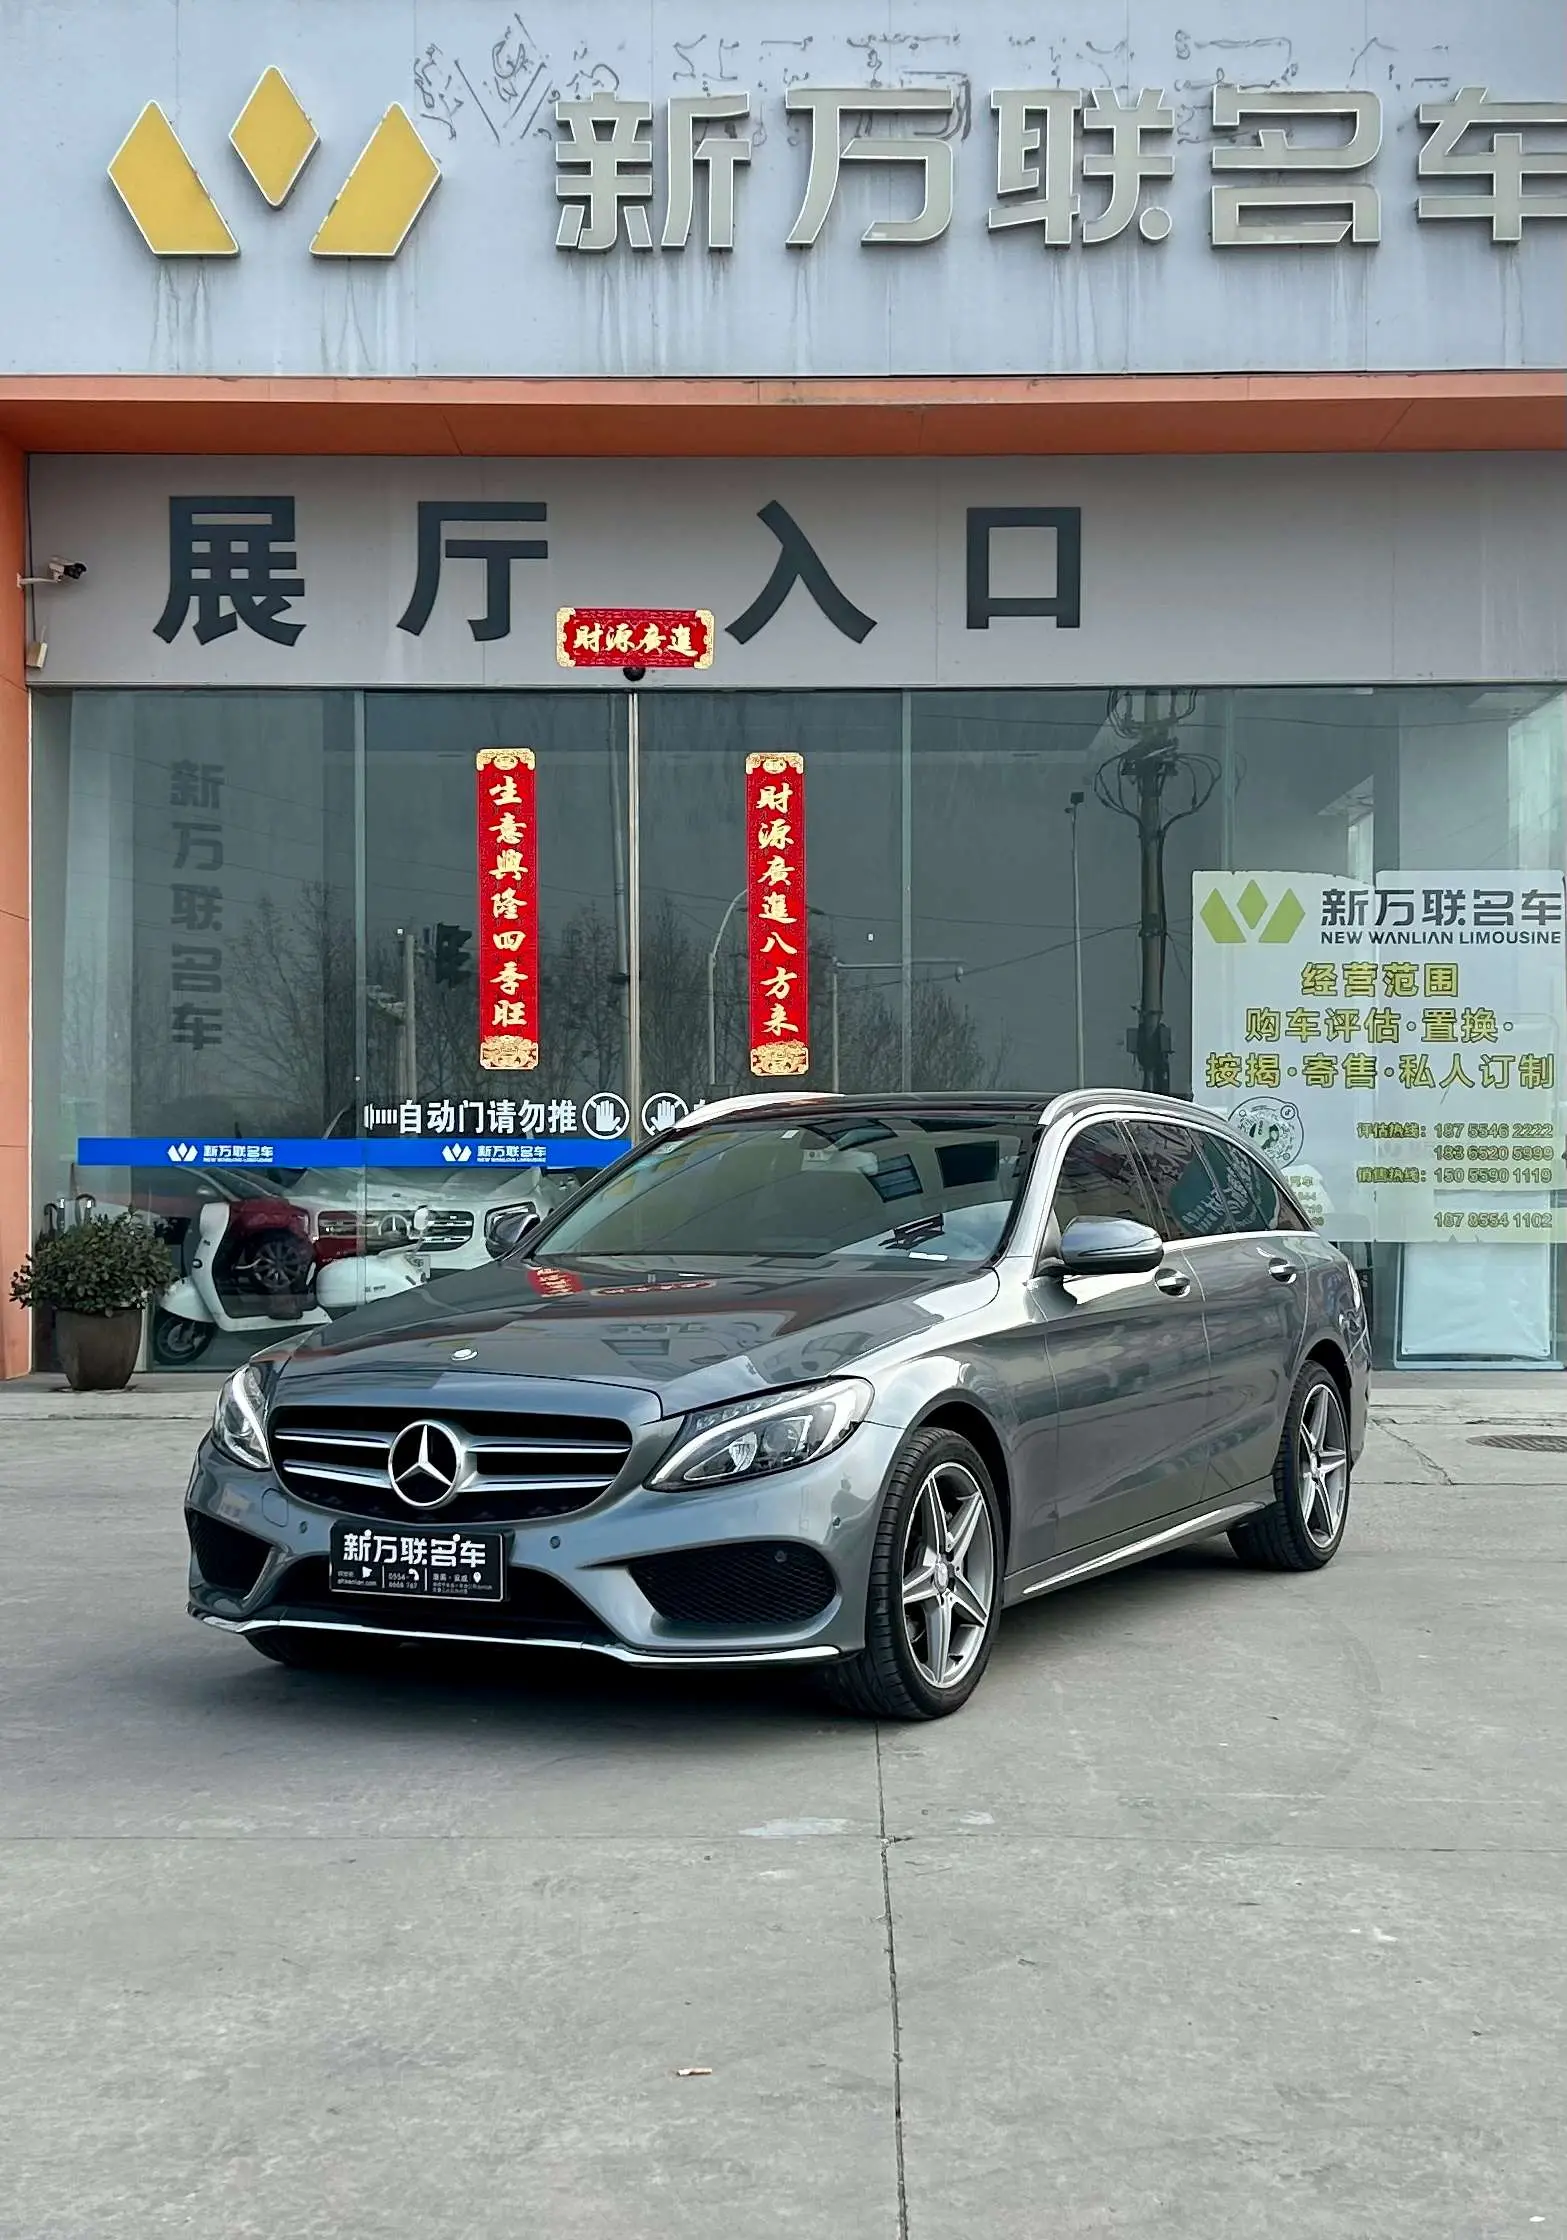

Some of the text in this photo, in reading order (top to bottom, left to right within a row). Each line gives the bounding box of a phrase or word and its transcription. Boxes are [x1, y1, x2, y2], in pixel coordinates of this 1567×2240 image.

[555, 86, 1567, 252] 新万联名车
[153, 495, 1081, 647] 展厅入口
[169, 758, 225, 1052] 新万联名车
[1321, 889, 1561, 926] 新万联名车
[1321, 931, 1561, 944] NEW WANLIAN LIMOUSINE
[1301, 962, 1459, 997] 经营范围
[398, 1099, 578, 1134] 自动门请勿推
[1434, 1123, 1464, 1138] 187
[1468, 1123, 1509, 1138] 5546
[1512, 1123, 1553, 1138] 2222
[1434, 1145, 1464, 1161] 183
[1467, 1146, 1508, 1161] 6520
[1434, 1168, 1464, 1183] 150
[1468, 1168, 1509, 1183] 5590
[1513, 1168, 1552, 1183] 1119
[1513, 1213, 1552, 1228] 1102
[343, 1532, 486, 1568] 新万联名车
